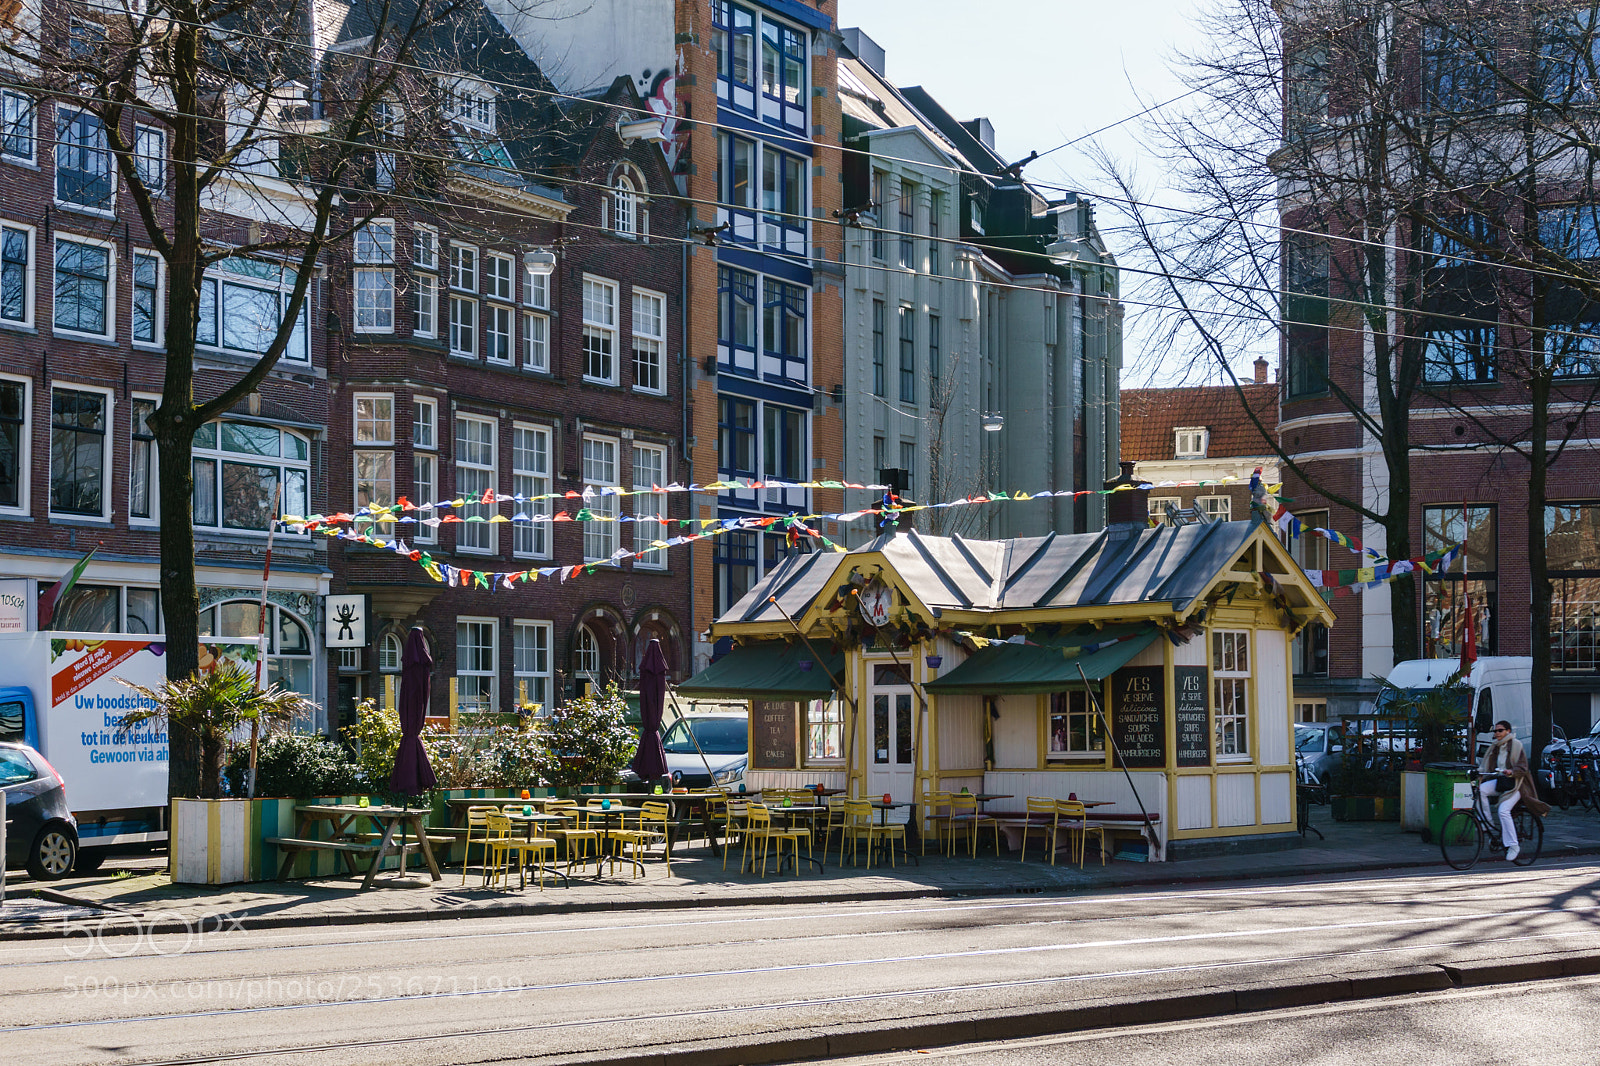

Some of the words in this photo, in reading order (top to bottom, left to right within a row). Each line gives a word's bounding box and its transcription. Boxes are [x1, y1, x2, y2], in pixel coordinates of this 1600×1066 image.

[73, 657, 89, 671] Word
[1126, 676, 1150, 691] YES
[1183, 675, 1199, 691] YES
[75, 694, 95, 709] Uw
[1133, 692, 1154, 702] SERVE
[764, 714, 786, 722] COFFEE
[1118, 713, 1159, 723] SANDWICHES
[1177, 713, 1206, 722] SANDWICHES
[769, 726, 780, 734] TEA
[1127, 723, 1150, 733] SOUPS
[1184, 723, 1200, 732] SOUPS
[80, 731, 98, 746] tot
[99, 729, 110, 745] in
[112, 729, 126, 745] de
[1124, 733, 1154, 743] SALADES
[1181, 733, 1203, 742] SALADES
[90, 749, 136, 764] Gewoon
[138, 746, 154, 762] via
[766, 750, 785, 758] CAKES
